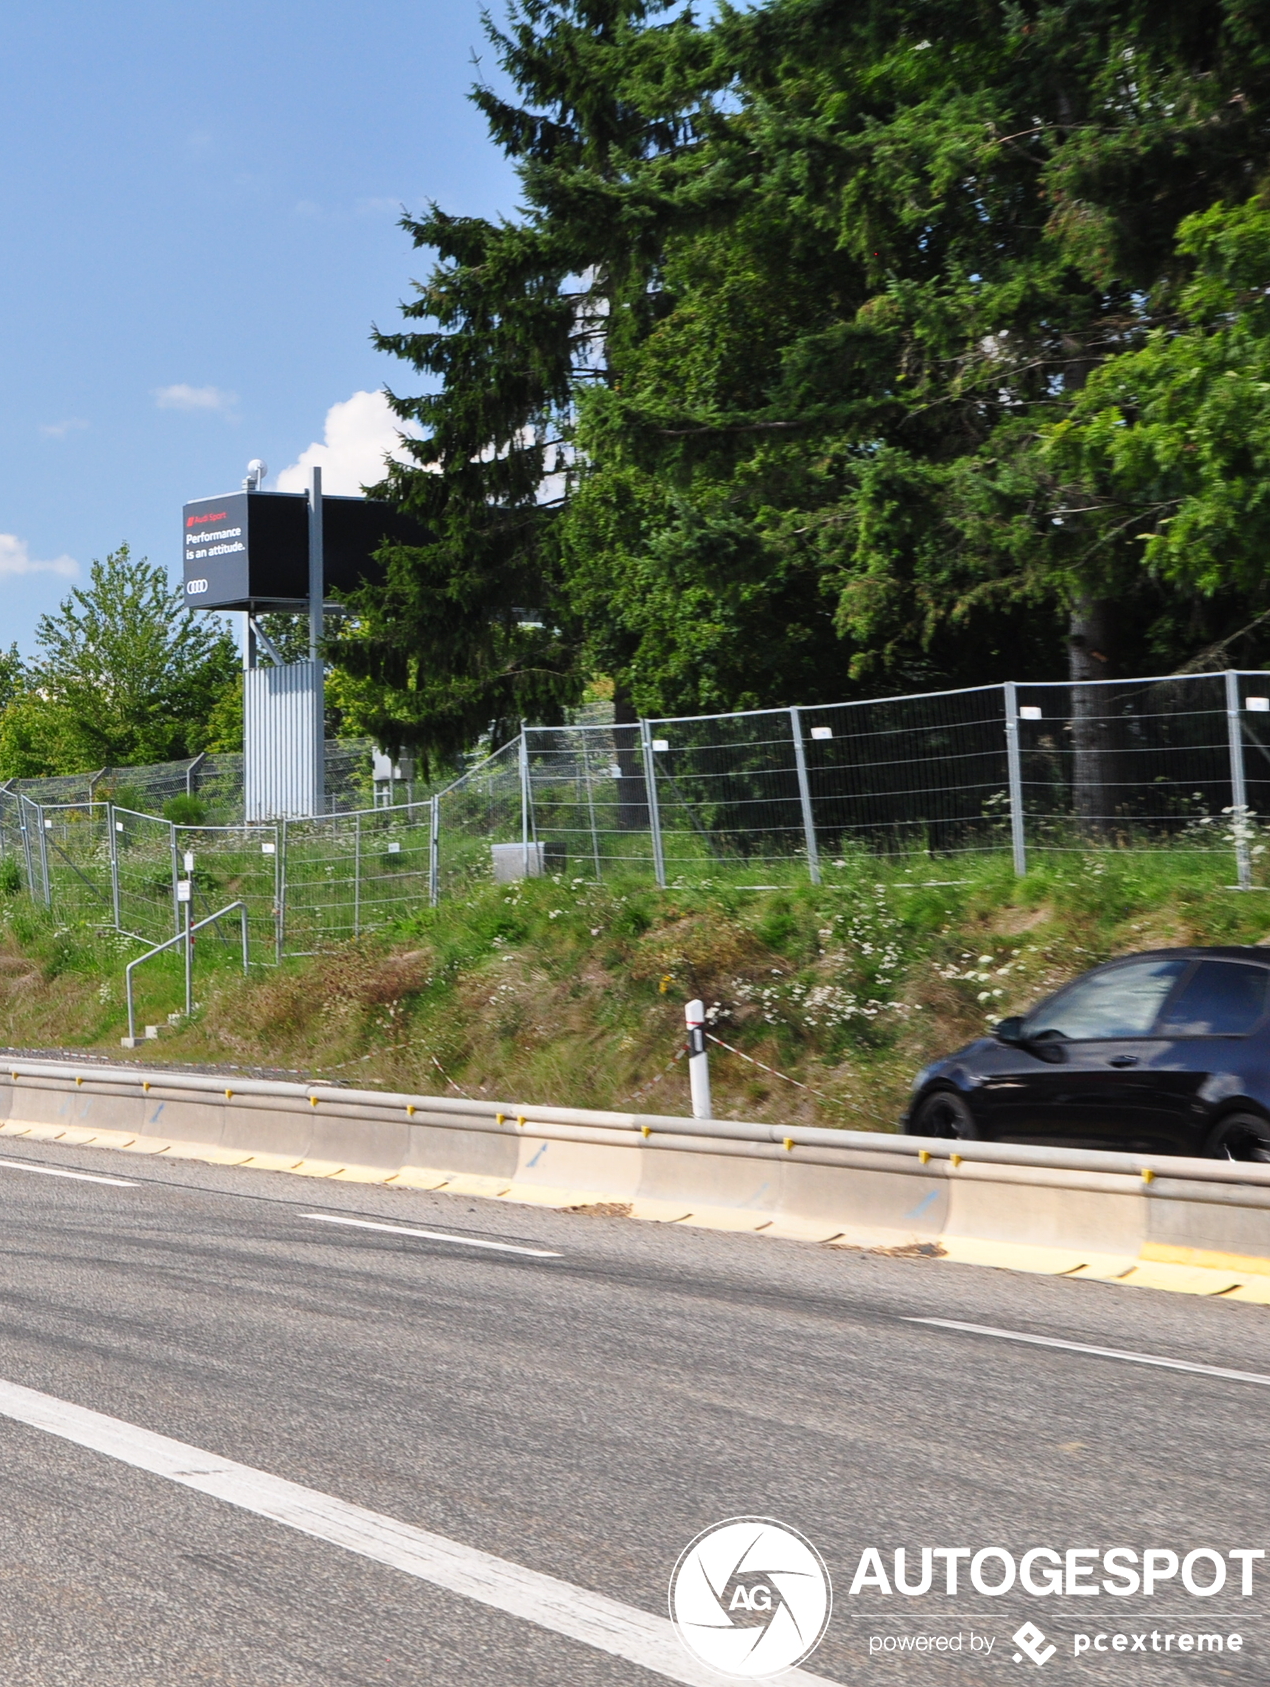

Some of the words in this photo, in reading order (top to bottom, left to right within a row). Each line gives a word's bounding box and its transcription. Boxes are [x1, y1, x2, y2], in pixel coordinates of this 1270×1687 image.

[209, 512, 227, 521] Sport
[186, 527, 241, 545] Performance
[186, 549, 195, 560] is
[195, 549, 207, 559] an
[208, 541, 246, 557] attitude.
